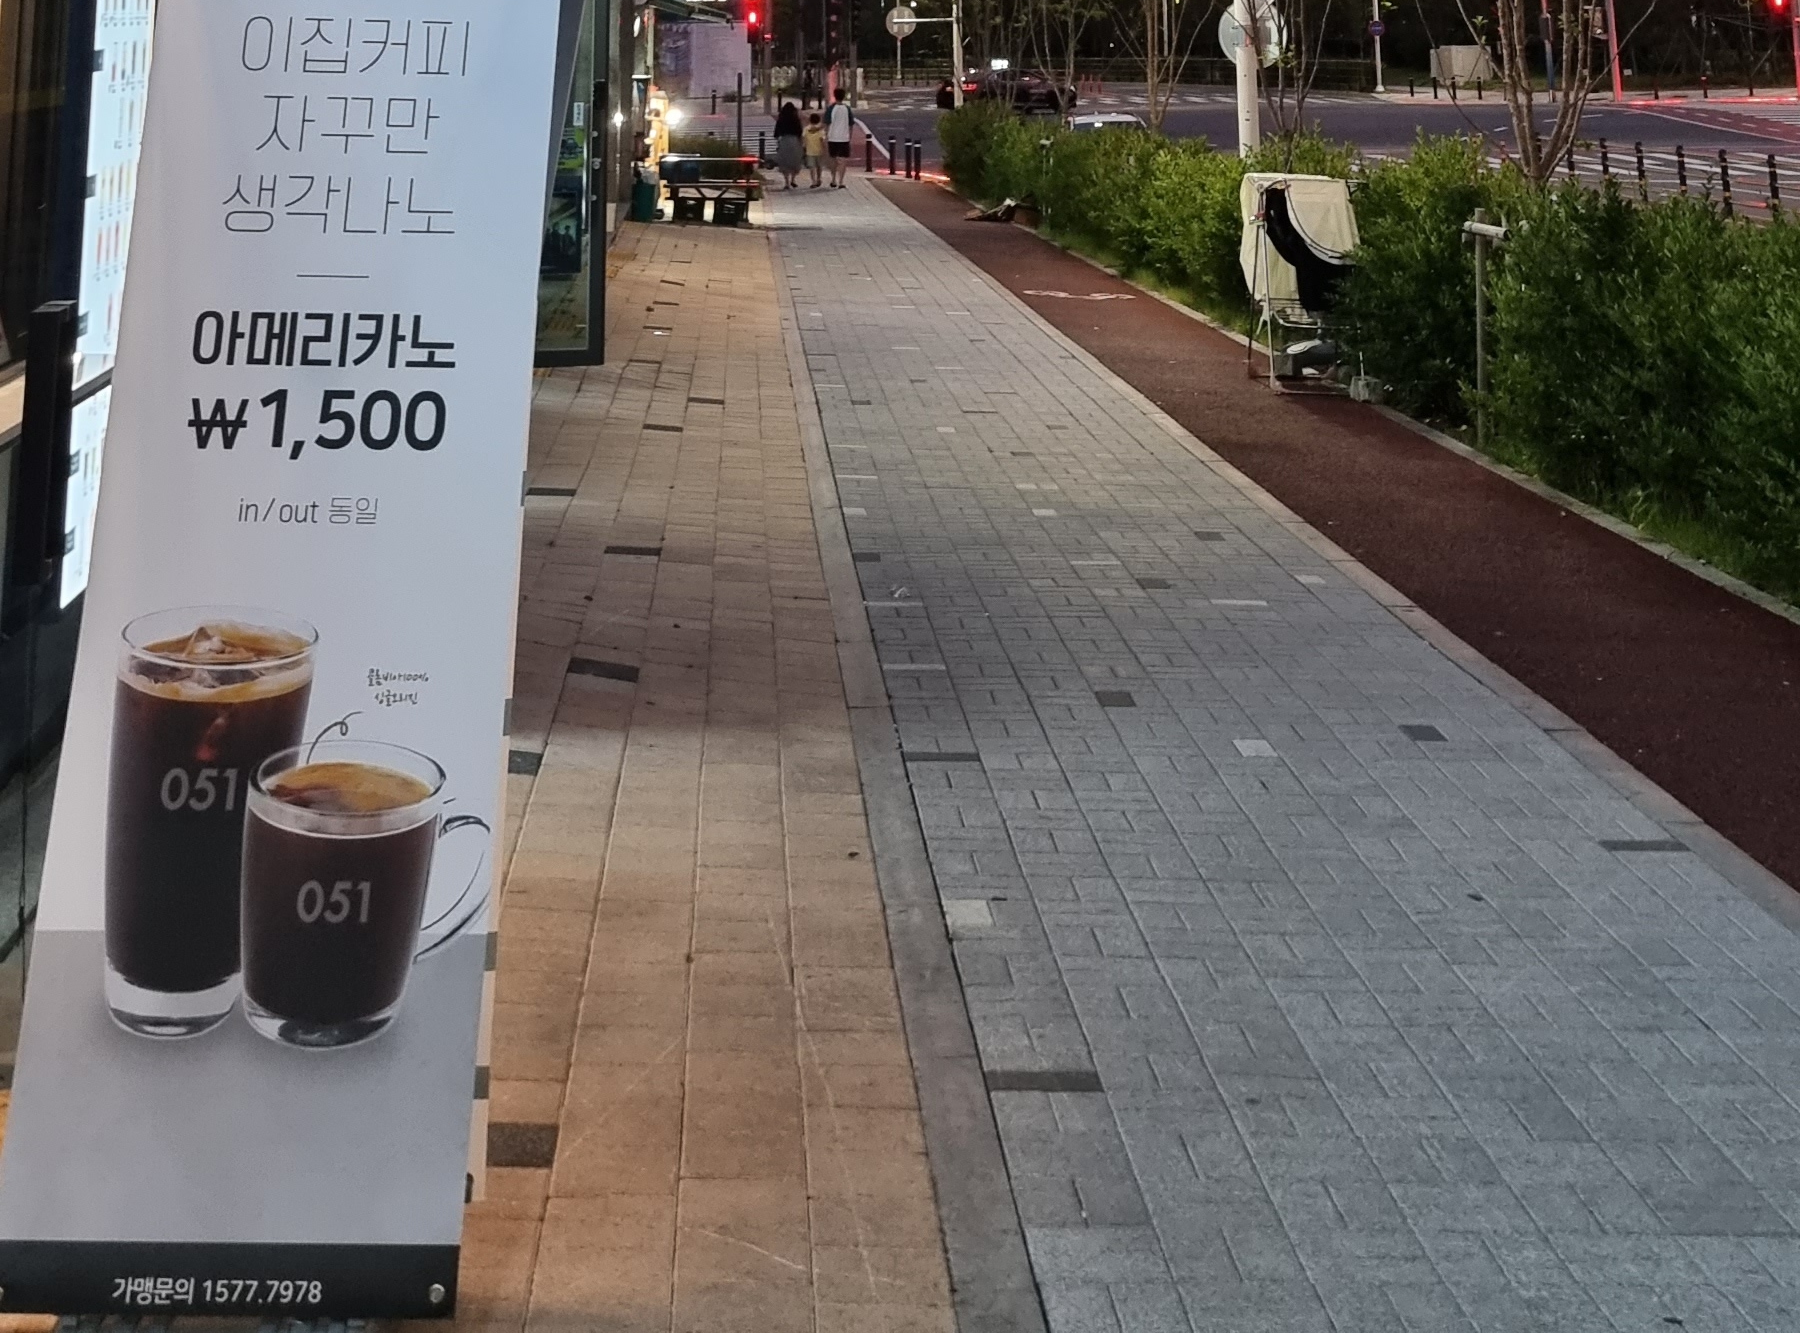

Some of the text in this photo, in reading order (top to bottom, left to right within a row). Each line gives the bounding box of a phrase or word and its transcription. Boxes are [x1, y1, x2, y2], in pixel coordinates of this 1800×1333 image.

[242, 16, 469, 76] 이집커피
[255, 95, 440, 154] 자꾸만
[222, 174, 455, 234] 생각나노
[192, 310, 456, 368] 아메리카노
[328, 497, 379, 525] 동일
[160, 768, 238, 811] 051
[296, 880, 371, 923] 051
[112, 1276, 323, 1306] 가맹문의 1577.7978
